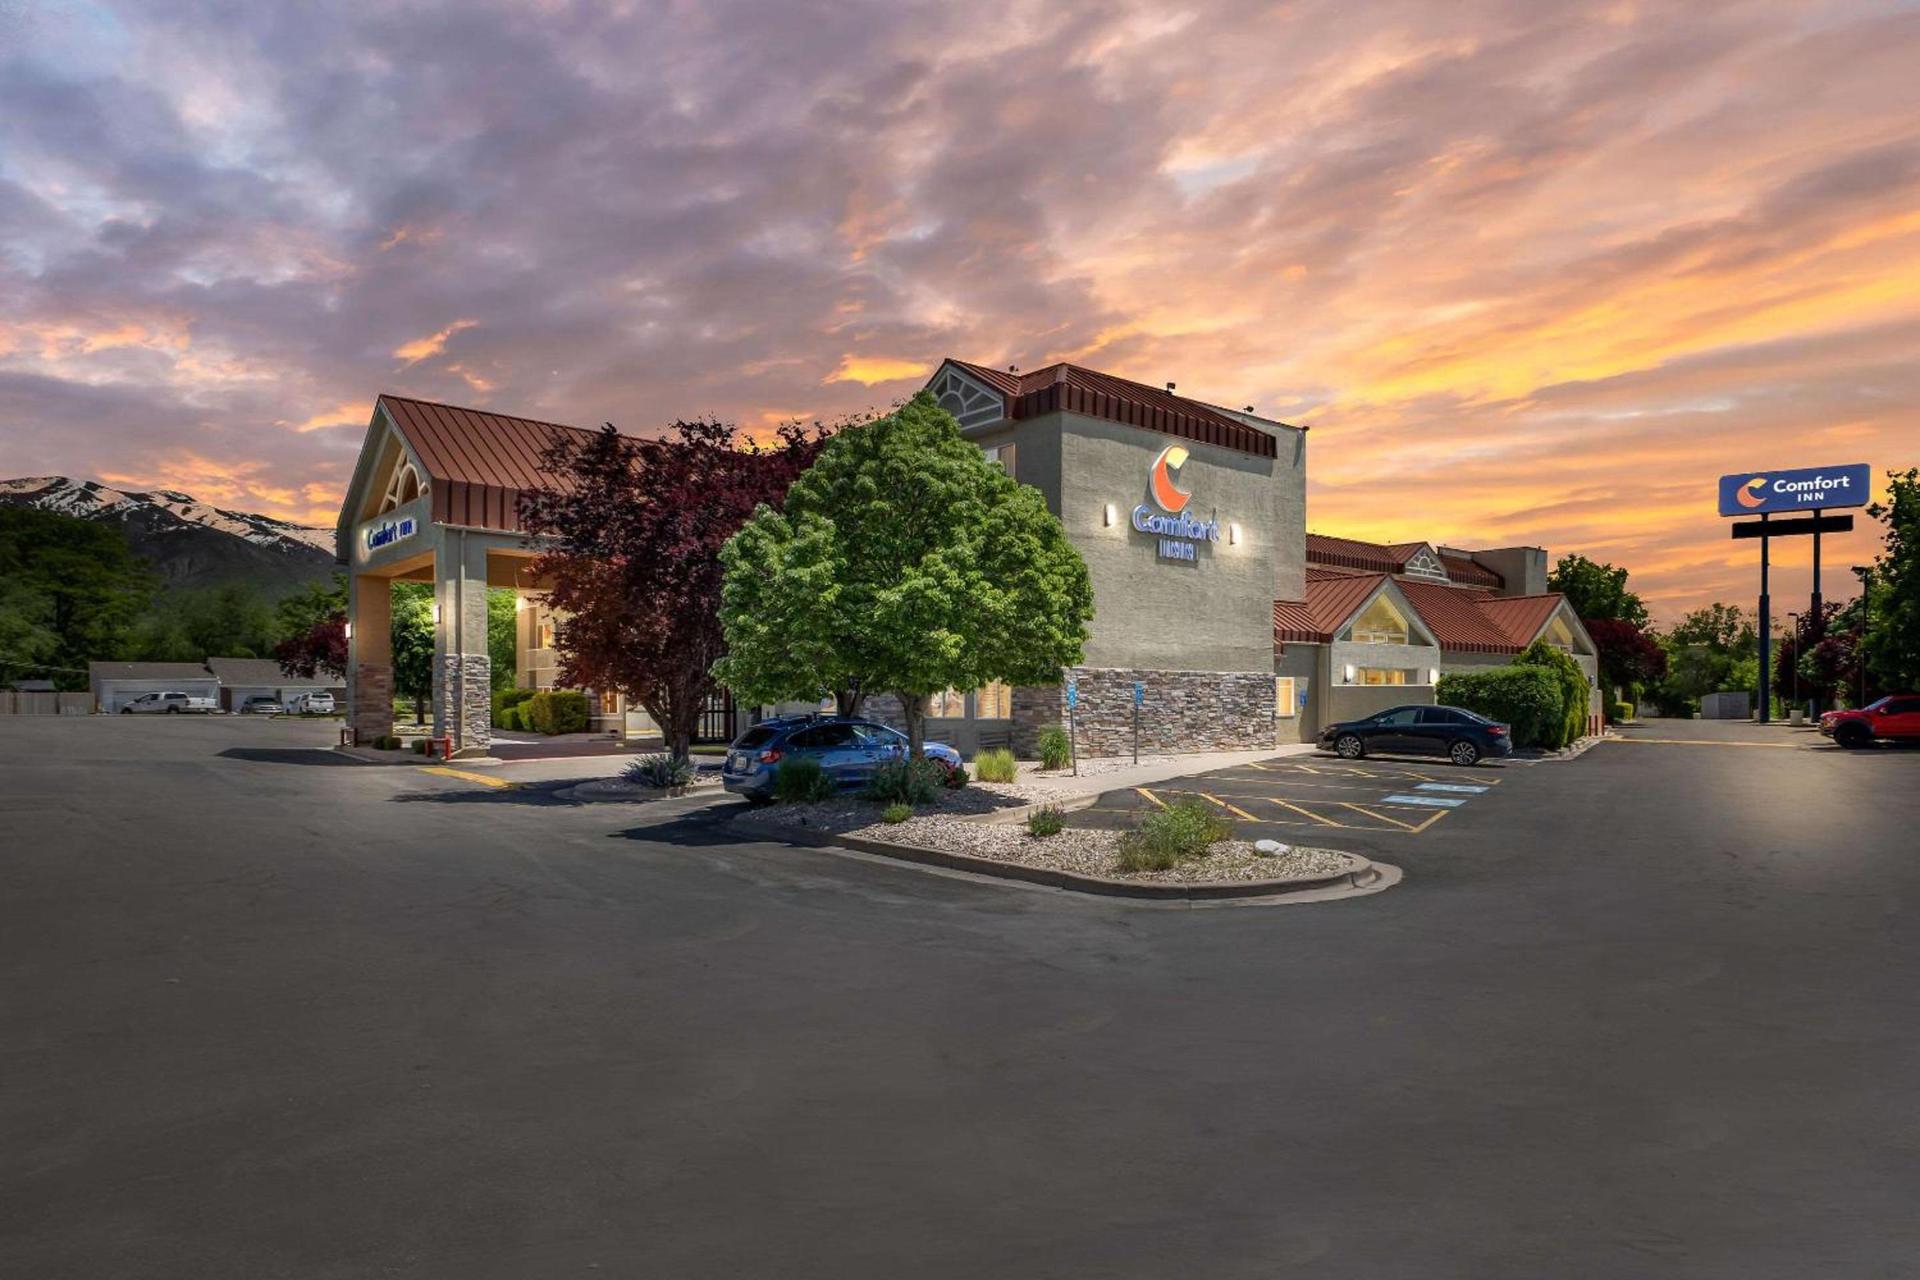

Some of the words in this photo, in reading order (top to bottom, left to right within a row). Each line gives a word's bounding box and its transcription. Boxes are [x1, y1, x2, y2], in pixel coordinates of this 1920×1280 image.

[1773, 476, 1850, 493] Comfort
[1797, 492, 1825, 502] INN
[1132, 504, 1220, 543] Comfort
[1159, 539, 1195, 561] INN
